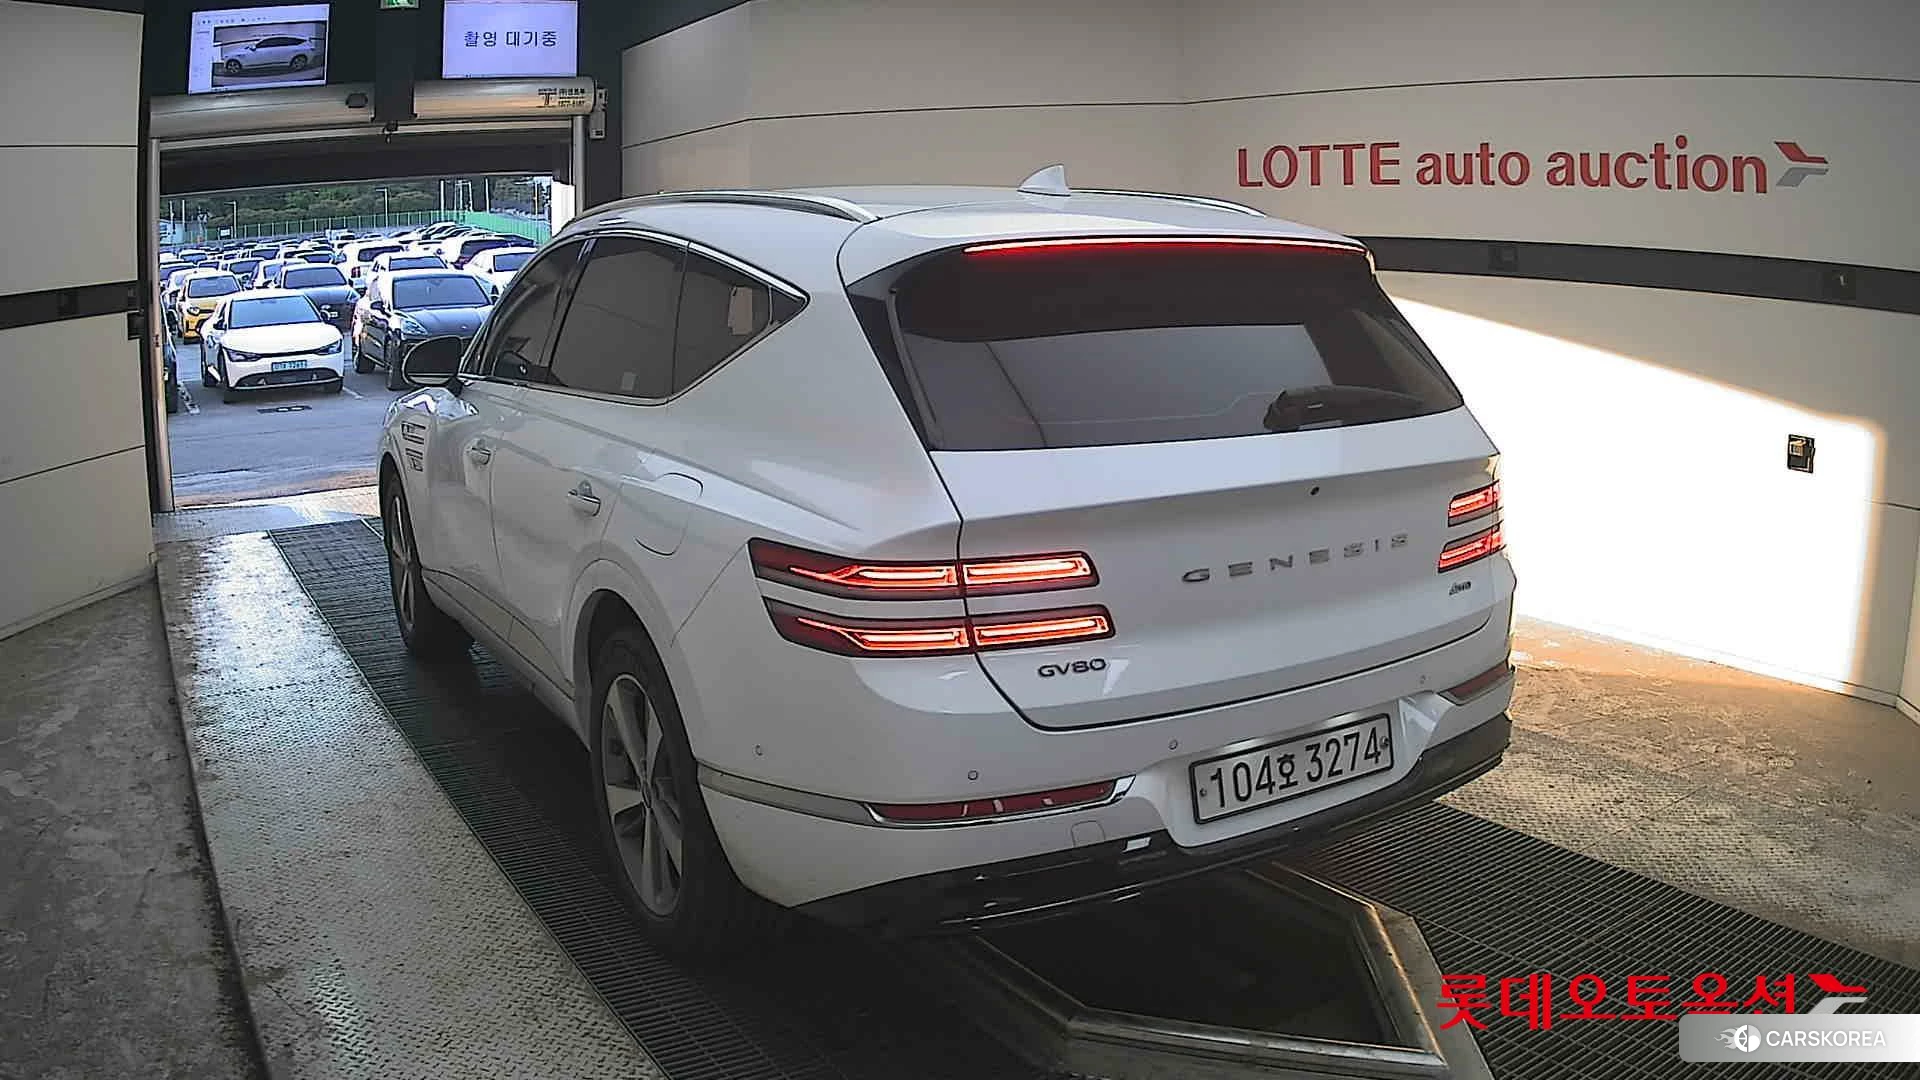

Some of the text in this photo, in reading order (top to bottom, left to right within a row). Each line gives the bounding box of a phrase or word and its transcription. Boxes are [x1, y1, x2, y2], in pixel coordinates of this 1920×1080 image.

[505, 31, 558, 48] 대기중
[1237, 135, 1768, 194] LOTTE auto auction
[1181, 534, 1409, 583] GENESIS
[1037, 658, 1107, 678] GV80
[1304, 726, 1382, 783] 3274
